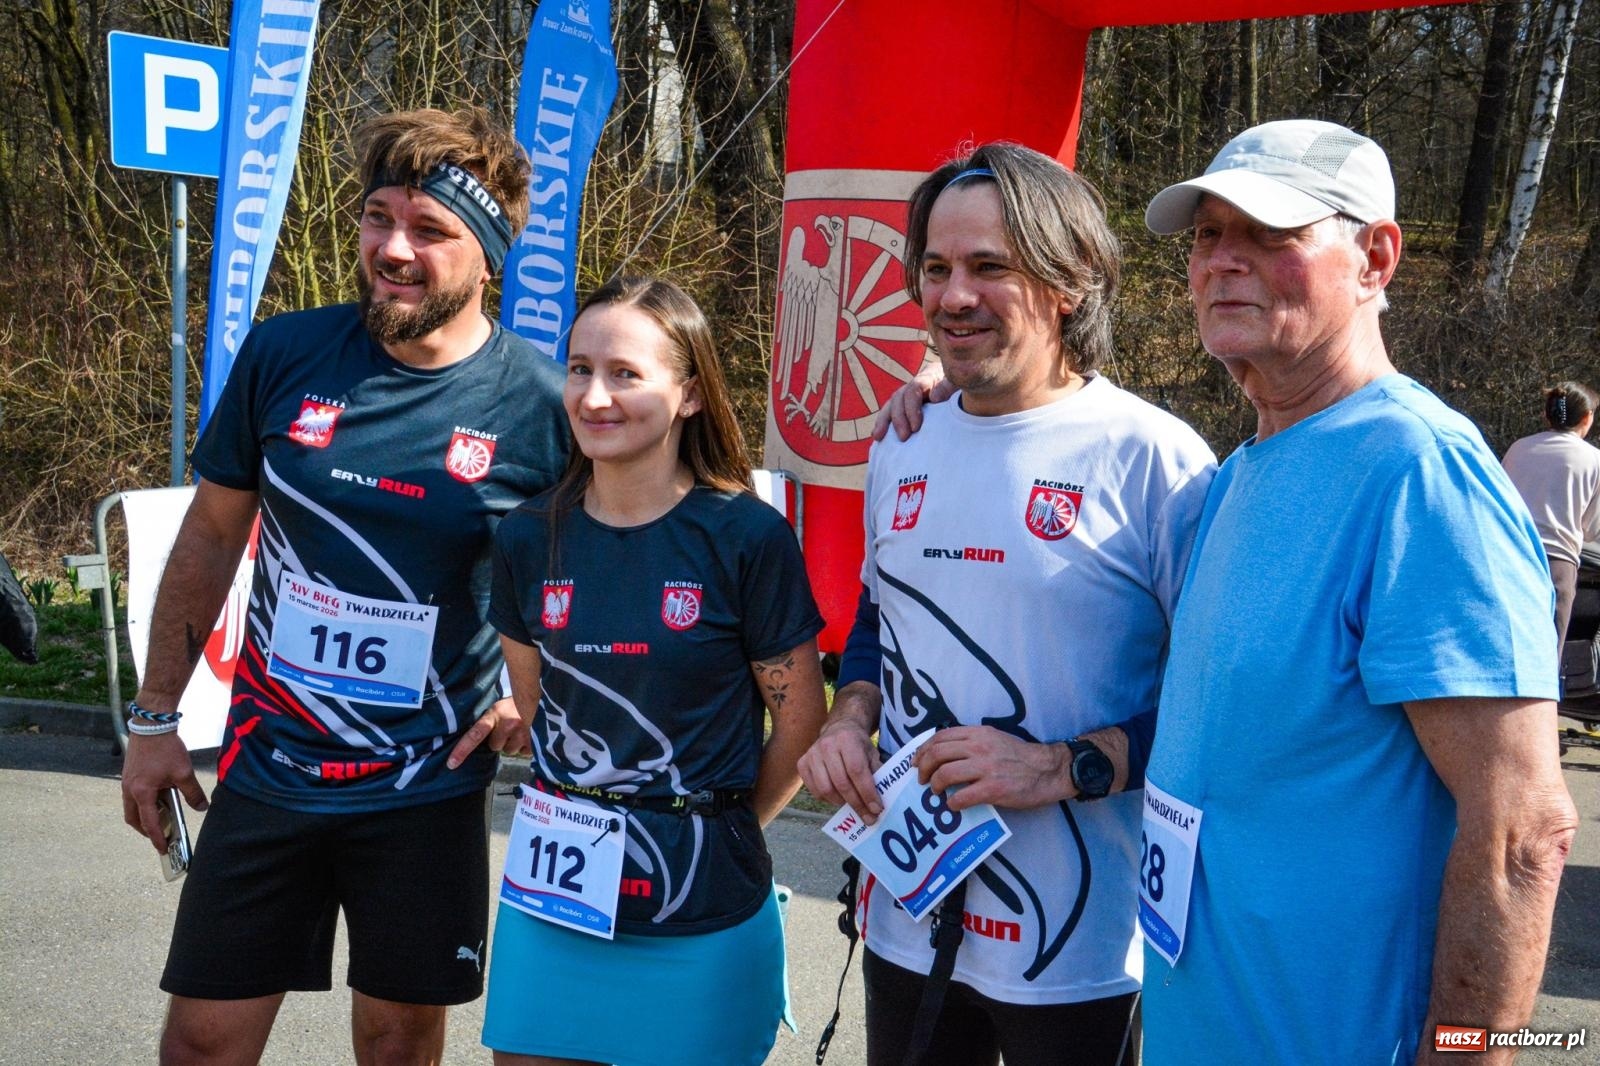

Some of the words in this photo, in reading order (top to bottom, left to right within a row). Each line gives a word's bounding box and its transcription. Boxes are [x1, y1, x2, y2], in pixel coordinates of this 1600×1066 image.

[144, 53, 219, 156] P
[304, 393, 346, 409] POLSKA
[454, 425, 498, 441] RACIBÓRZ
[898, 474, 928, 486] POLSKA
[1034, 478, 1085, 493] RACIBÓRZ
[543, 578, 574, 586] POLSKA
[664, 581, 704, 590] RACIBÓRZ
[288, 594, 296, 602] 15
[296, 597, 320, 611] marzec
[320, 606, 338, 617] 2026
[290, 581, 310, 597] XIV
[313, 590, 340, 609] BIEG
[345, 601, 425, 622] TWARDZIELA
[310, 624, 388, 675] 116
[837, 814, 858, 835] XIV
[876, 752, 917, 795] TWARDZ
[534, 798, 552, 816] BIEG
[555, 806, 612, 830] TWARDZIEL
[849, 831, 858, 843] 15
[856, 824, 868, 838] mar
[880, 787, 962, 873] 048
[530, 835, 586, 894] 112
